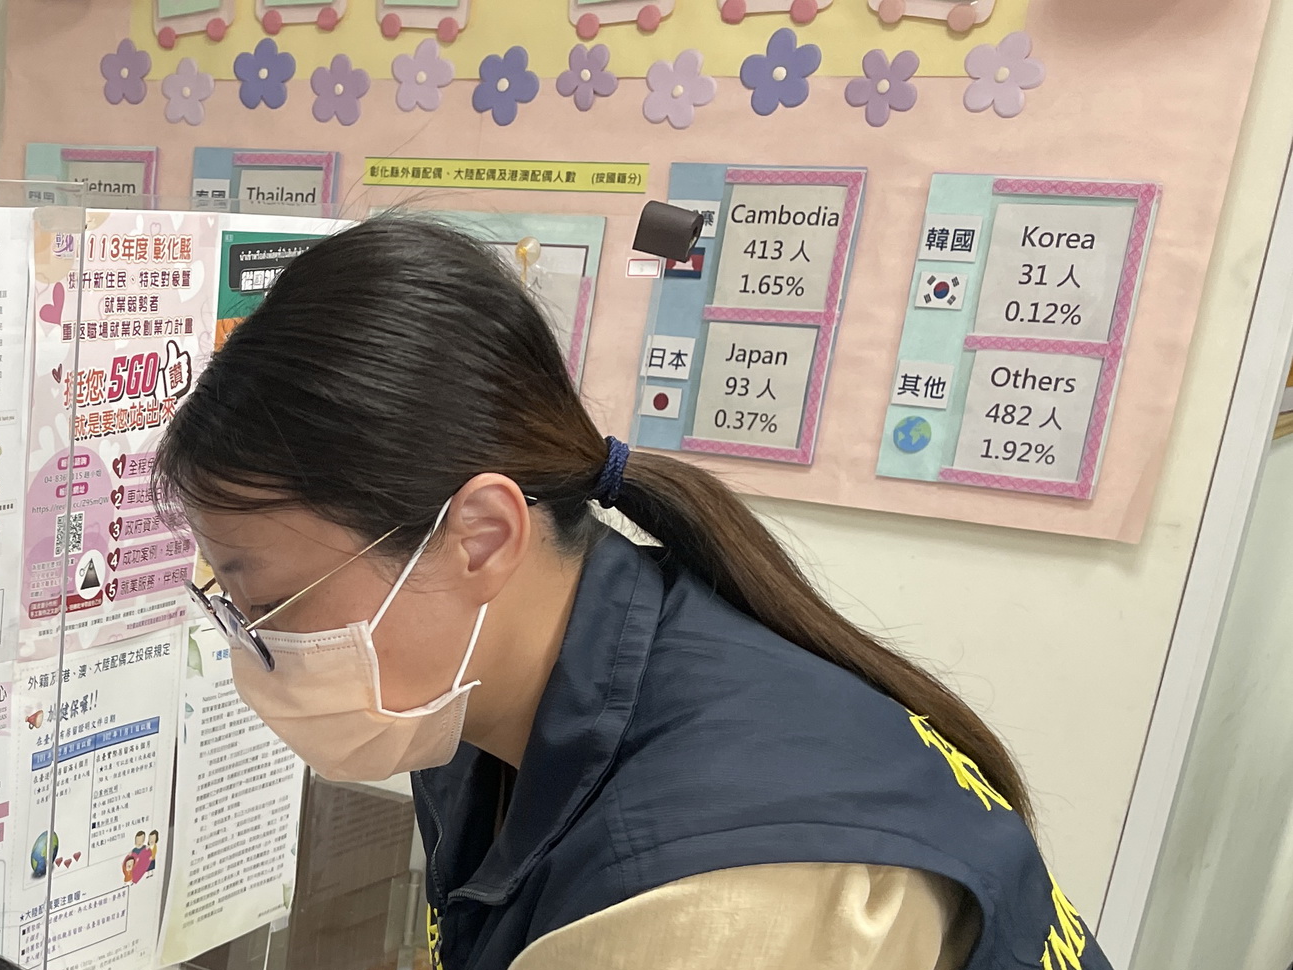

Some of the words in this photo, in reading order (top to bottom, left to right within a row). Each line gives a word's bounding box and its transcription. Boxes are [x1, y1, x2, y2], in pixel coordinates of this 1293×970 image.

[74, 178, 136, 195] Vietnam
[246, 186, 316, 205] Thailand
[730, 203, 840, 229] Cambodia
[87, 236, 149, 262] 113年度
[153, 236, 192, 261] 彰化縣
[924, 227, 975, 254] 韓國
[1021, 225, 1097, 251] Korea
[743, 240, 783, 261] 413
[789, 240, 811, 263] 人
[737, 274, 805, 298] 1.65%
[1018, 265, 1048, 287] 31
[1056, 264, 1082, 289] 人
[104, 296, 159, 314] 就業弱勢者
[1004, 301, 1083, 327] 0.12%
[62, 317, 194, 341] 重返職場就業及創業力計畫
[647, 347, 689, 371] 日本
[725, 343, 789, 368] Japan
[64, 367, 104, 408] 挺您
[107, 351, 160, 400] 5GO
[169, 361, 185, 390] 讚
[897, 373, 947, 400] 其他
[990, 367, 1077, 394] Others
[724, 377, 751, 398] 93
[756, 378, 777, 401] 人
[713, 410, 778, 434] 0.37%
[984, 404, 1033, 428] 482
[1039, 406, 1063, 431] 人
[979, 438, 1057, 466] 1.92%
